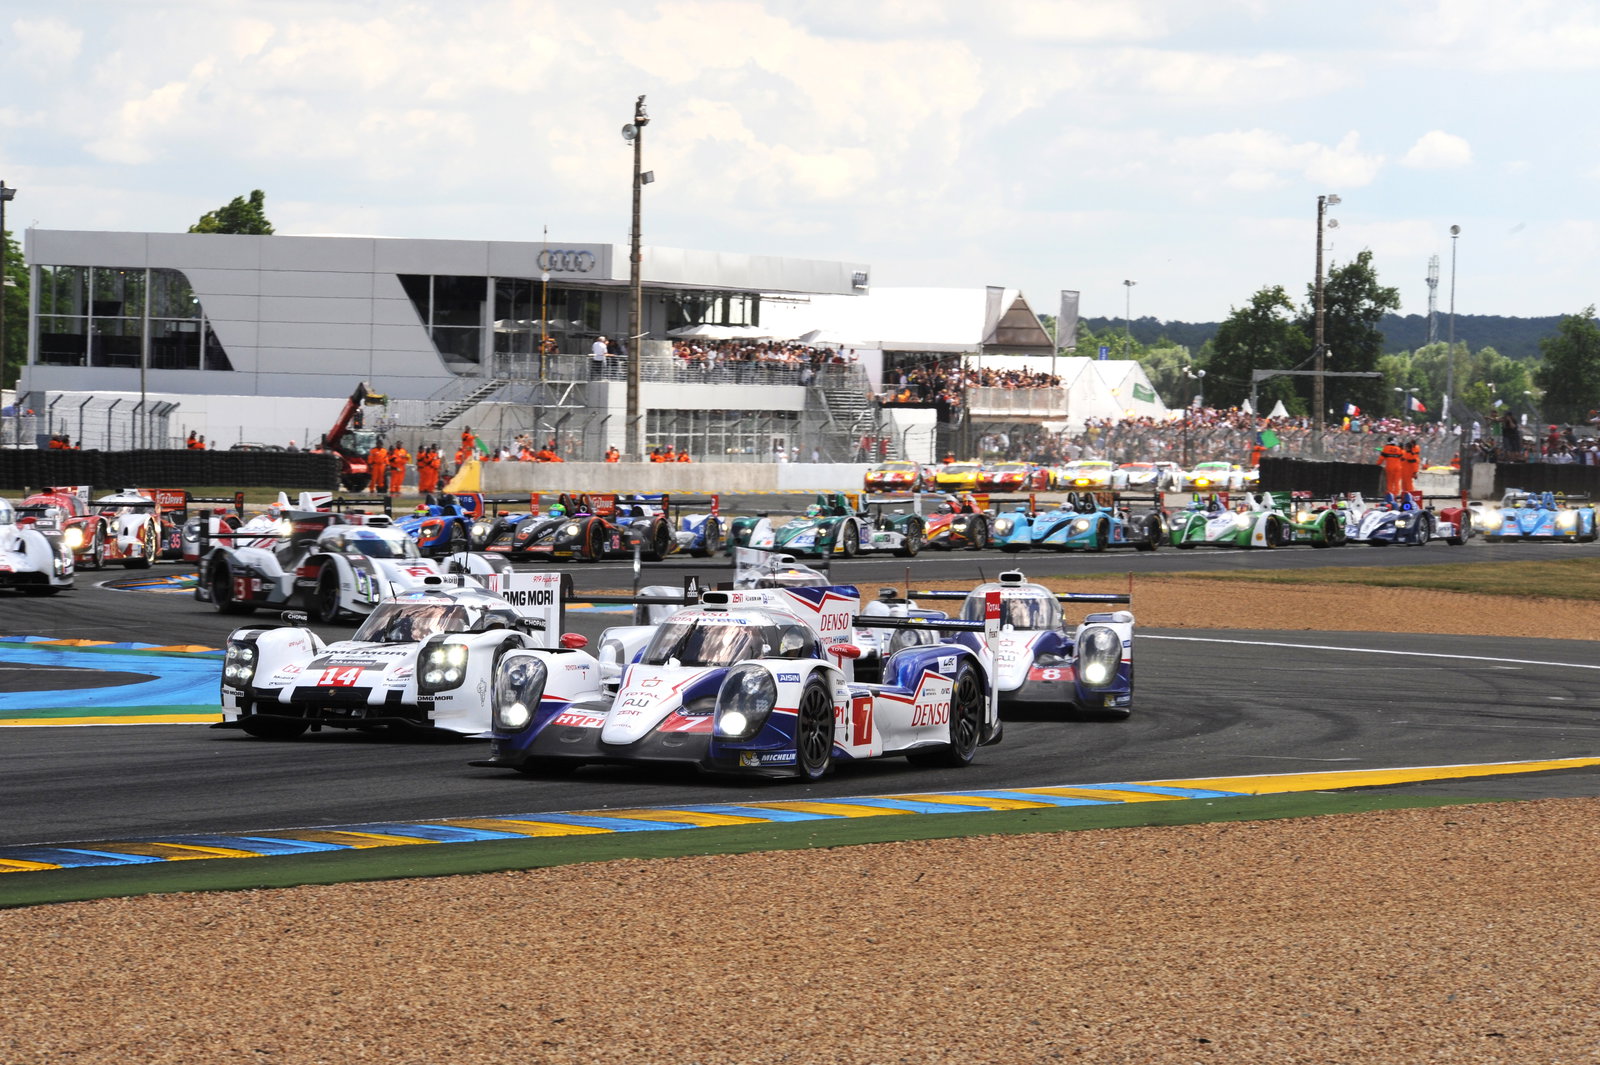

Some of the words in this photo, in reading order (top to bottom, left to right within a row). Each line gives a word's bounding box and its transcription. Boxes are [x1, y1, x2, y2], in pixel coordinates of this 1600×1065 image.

[170, 533, 181, 549] 35
[236, 578, 246, 599] 3
[502, 590, 526, 607] DMG
[527, 589, 554, 606] MORI
[986, 602, 1001, 612] TOTAL
[820, 612, 850, 632] DENSO
[319, 668, 357, 685] 14
[1041, 668, 1062, 681] 8
[624, 692, 662, 700] TOTAL
[554, 715, 582, 725] HY
[862, 703, 872, 740] 7
[911, 702, 950, 727] DENSO
[676, 715, 709, 731] 7
[761, 752, 796, 761] MICHELIN
